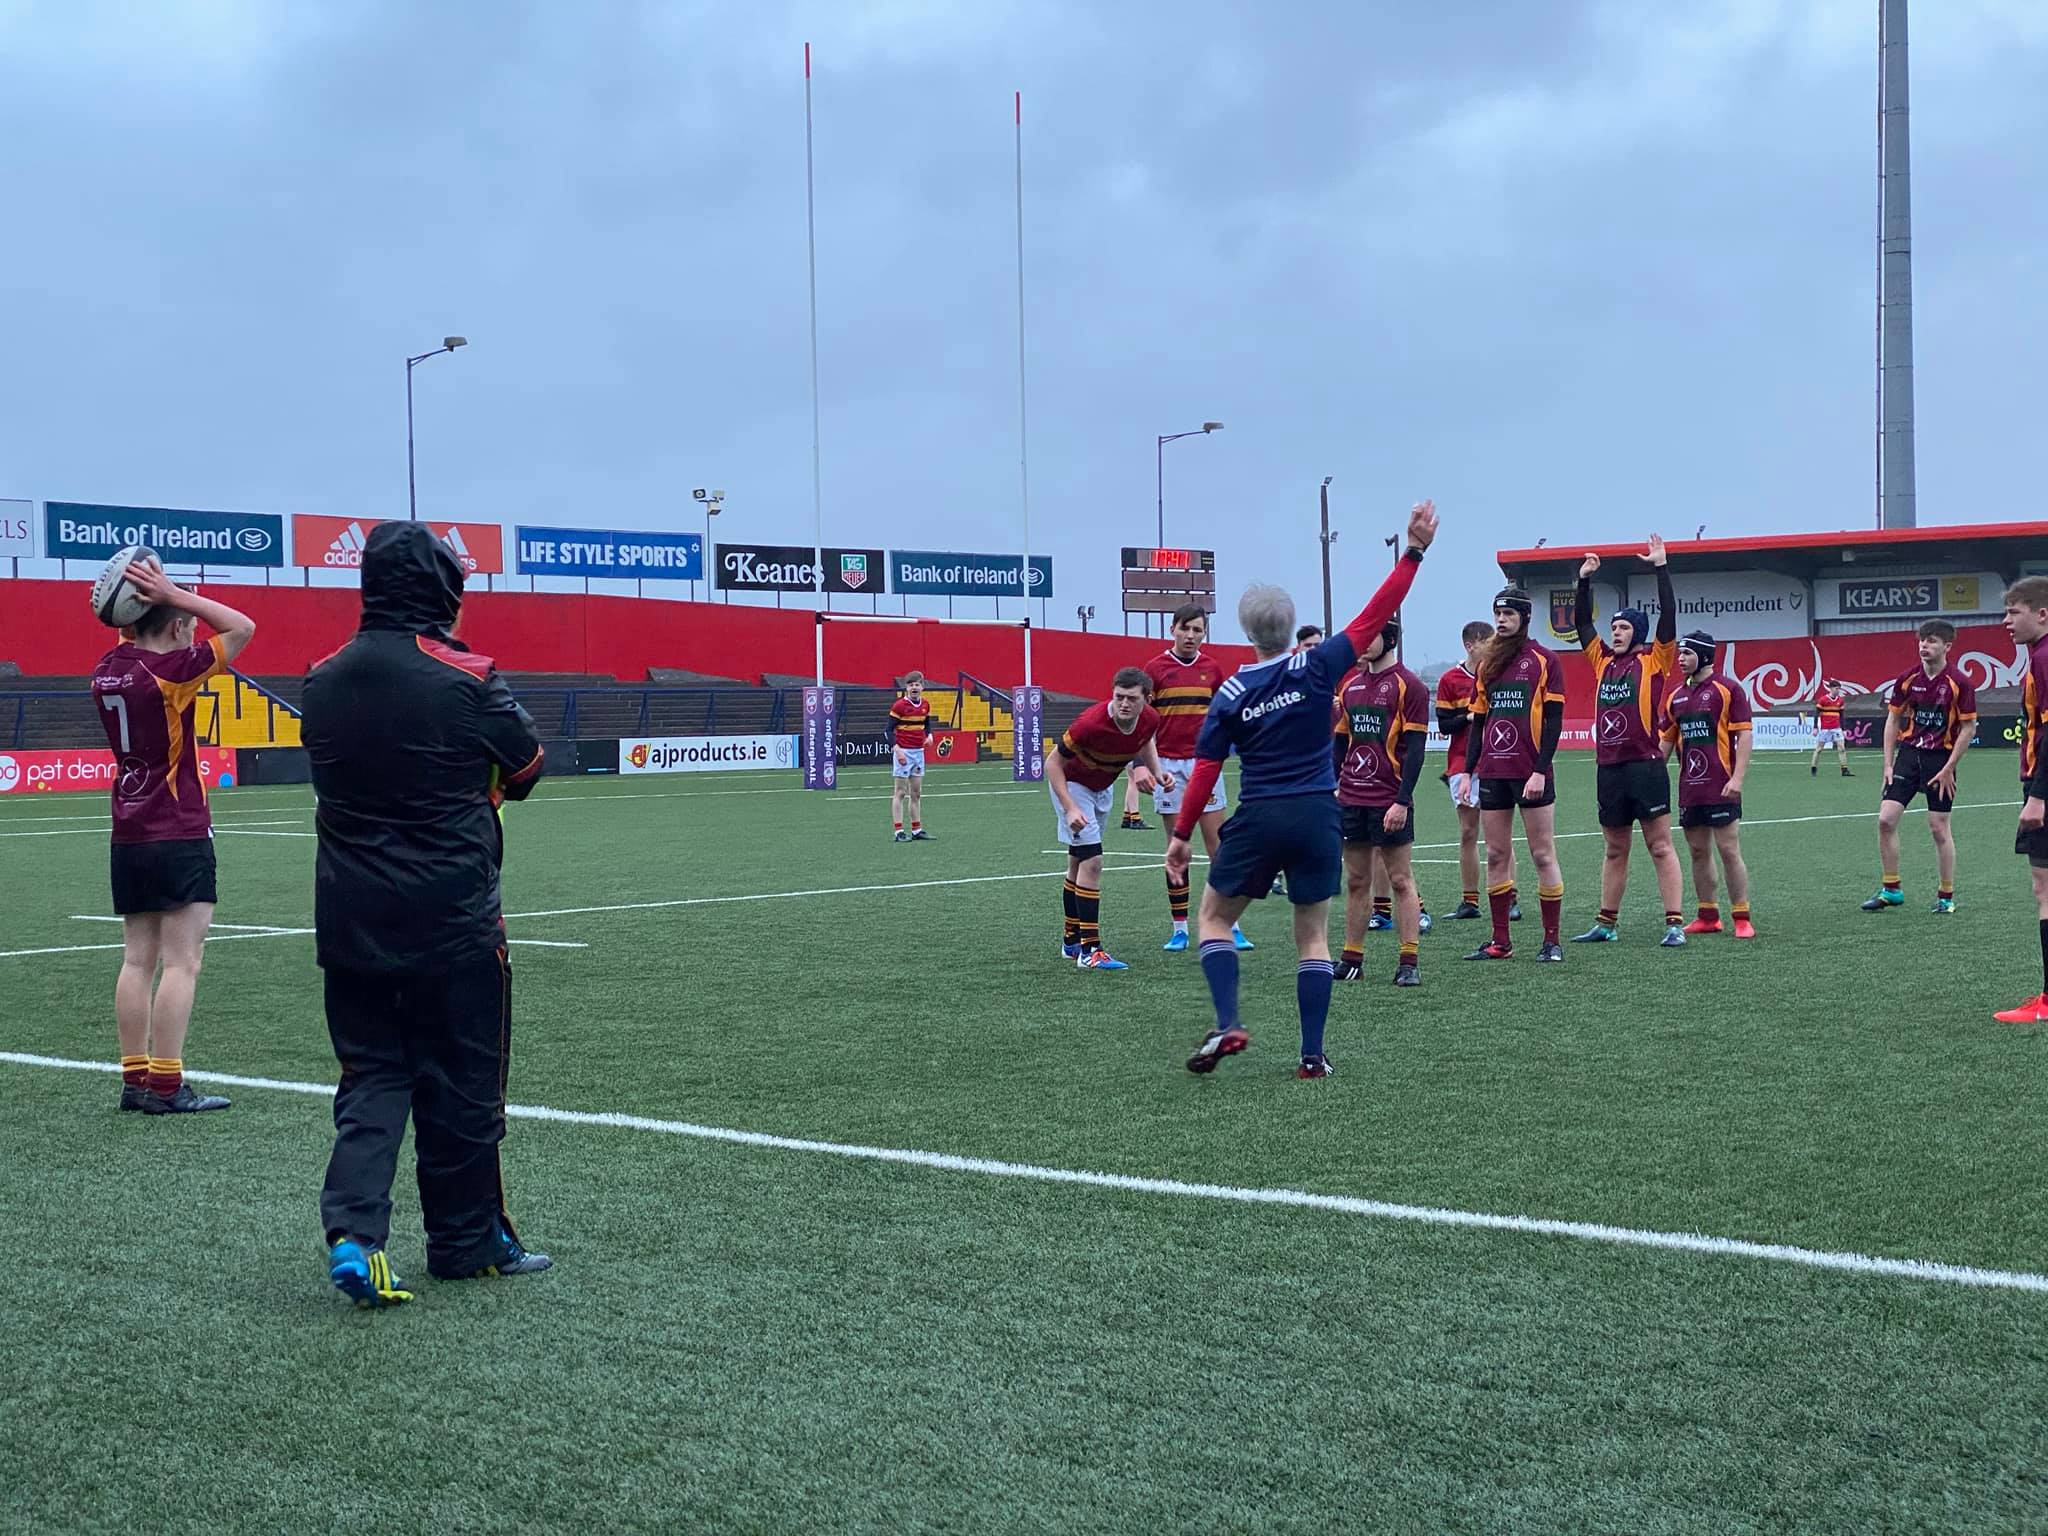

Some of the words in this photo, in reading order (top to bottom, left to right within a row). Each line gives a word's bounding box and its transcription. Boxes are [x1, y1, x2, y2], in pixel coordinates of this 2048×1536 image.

[59, 519, 121, 545] Bank
[124, 523, 149, 547] of
[152, 524, 232, 550] Ireland
[324, 550, 362, 567] adid
[520, 540, 556, 563] LIFE
[560, 542, 614, 566] STYLE
[618, 544, 687, 568] SPORTS
[845, 557, 862, 570] TAG
[725, 552, 825, 584] Keanes
[901, 564, 942, 583] Bank
[944, 565, 961, 583] of
[963, 566, 1018, 585] Ireland
[1553, 598, 1576, 606] RUG
[1636, 599, 1663, 616] Iris
[1678, 595, 1784, 618] Independent
[1844, 585, 1931, 609] KEARYS
[102, 694, 130, 752] 7
[1575, 730, 1590, 740] TRY
[652, 741, 767, 769] ajproducts.ie
[846, 741, 873, 755] DALY
[27, 759, 63, 786] pat
